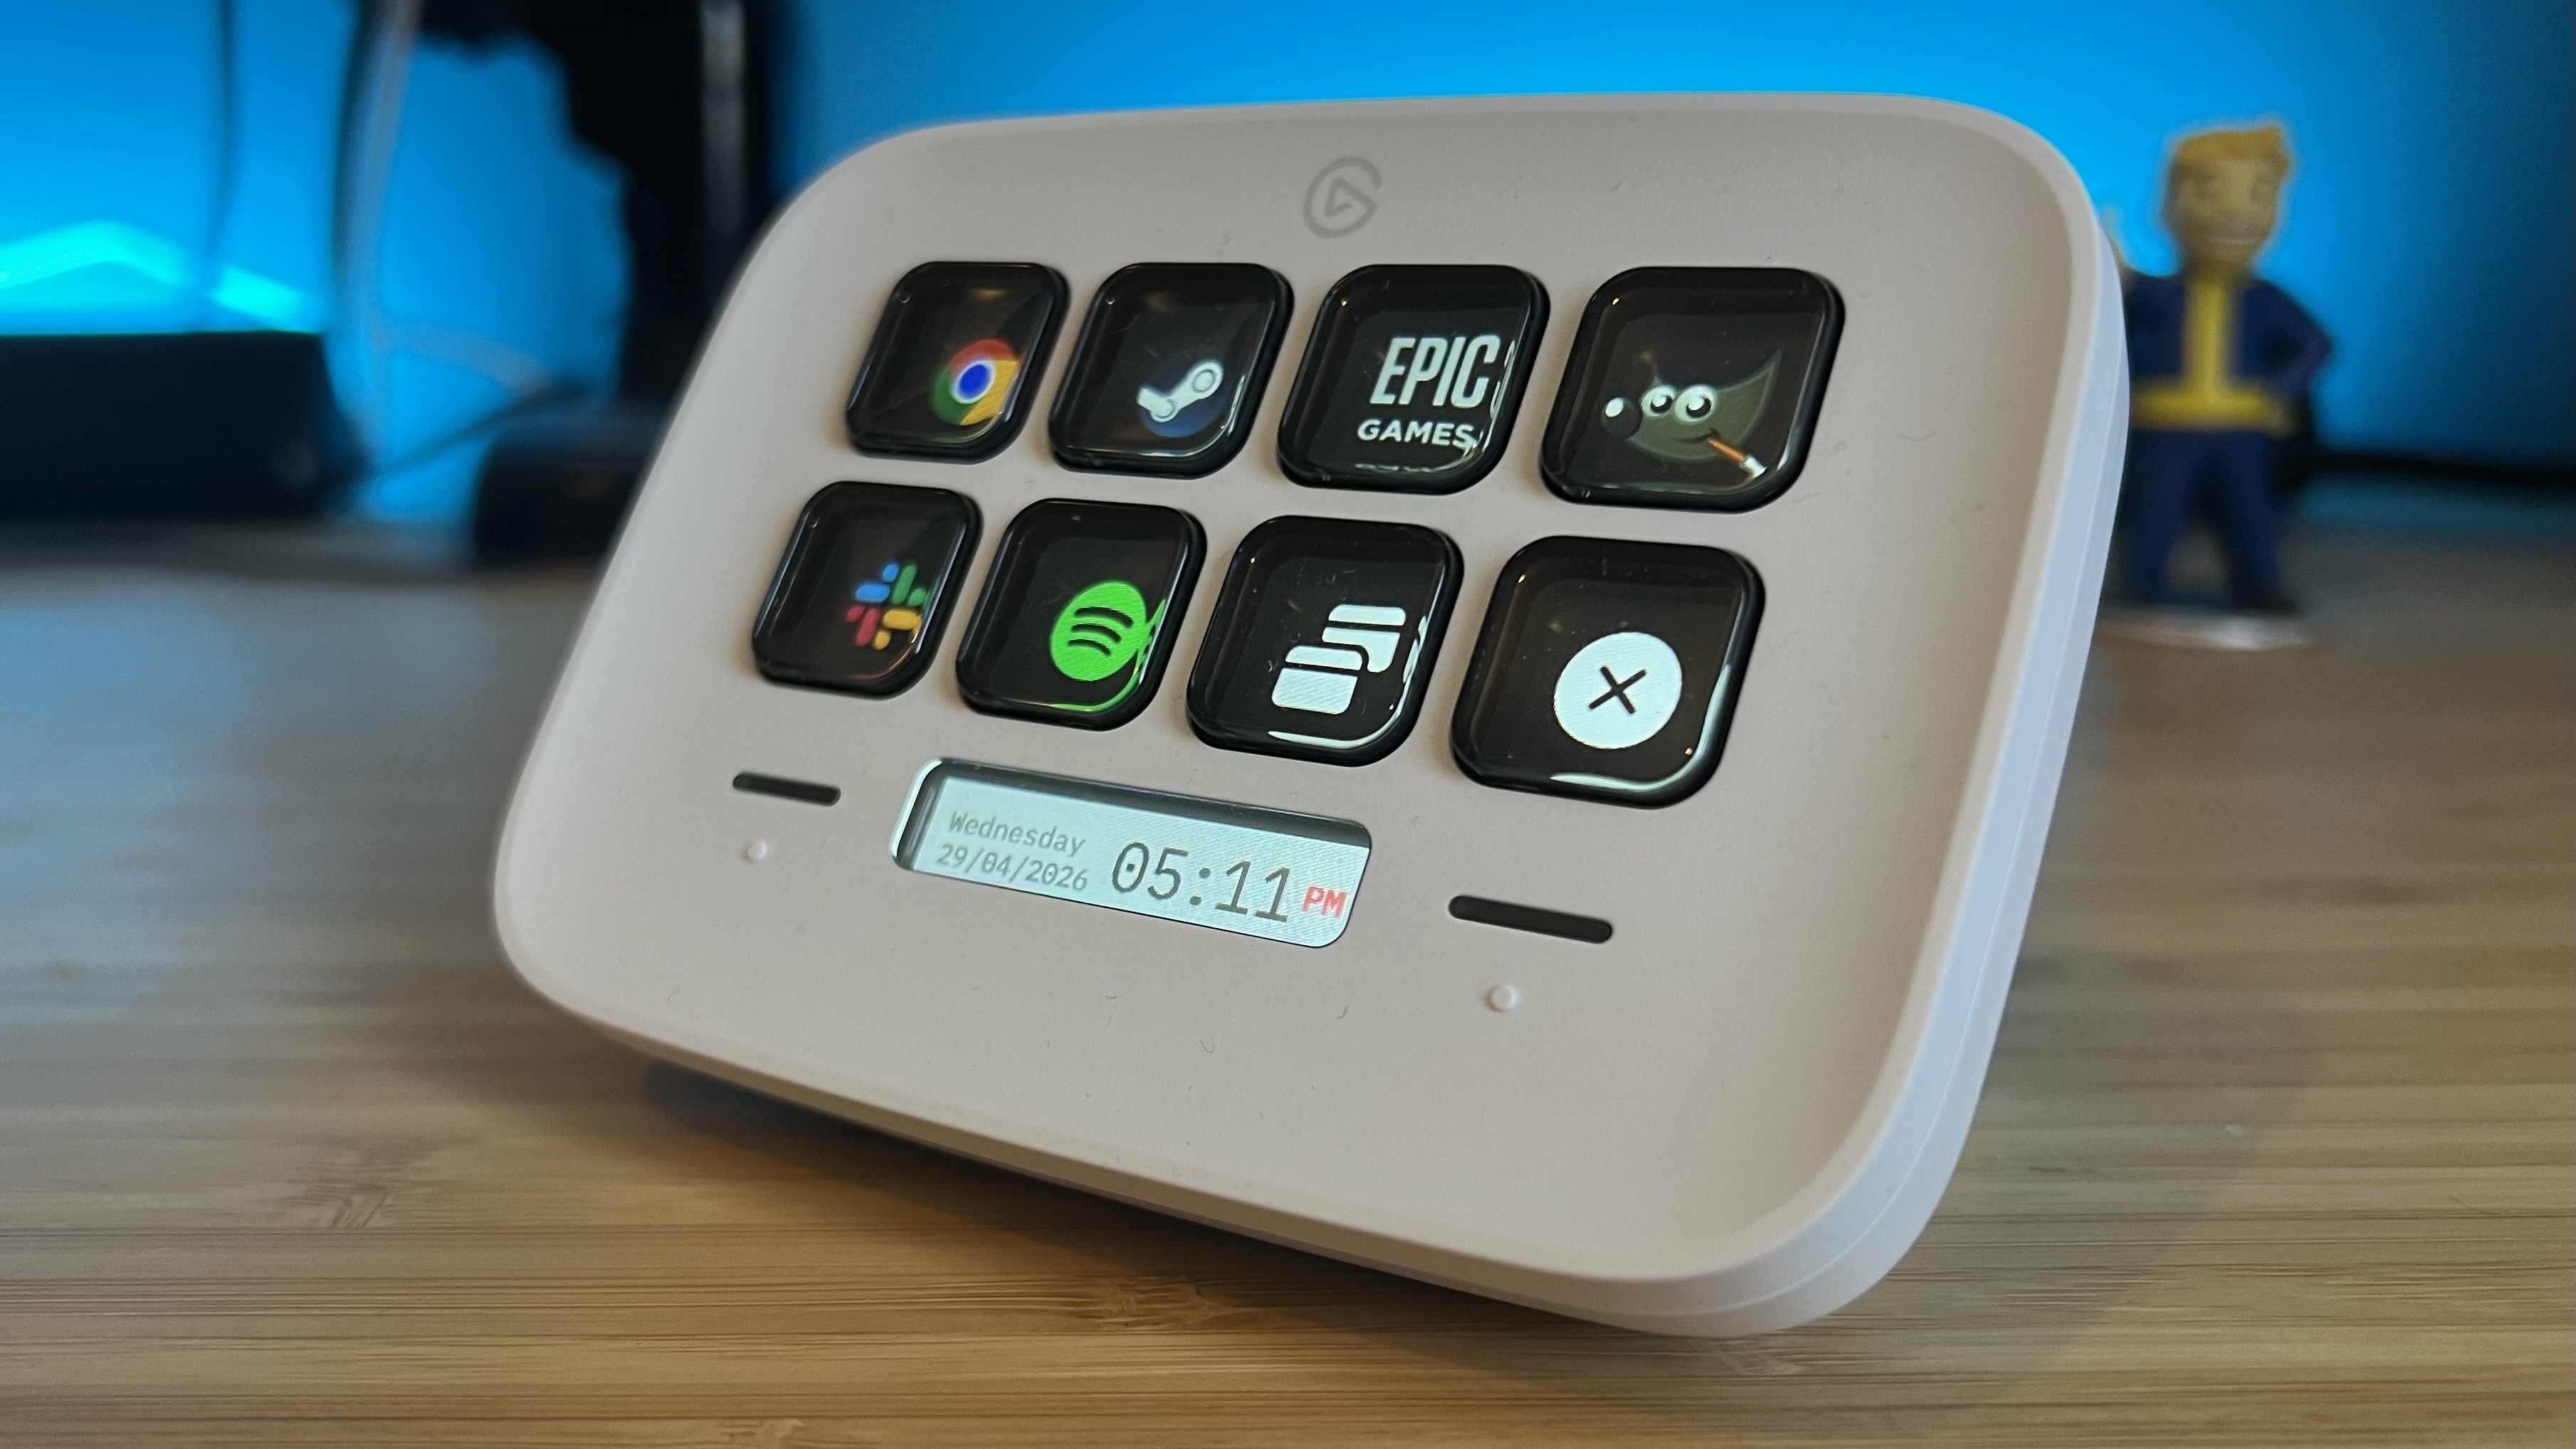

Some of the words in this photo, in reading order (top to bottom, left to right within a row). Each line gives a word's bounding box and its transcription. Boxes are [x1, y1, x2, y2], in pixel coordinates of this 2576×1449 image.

[1370, 334, 1500, 409] EPIC
[1357, 418, 1477, 448] GAMES
[949, 811, 1086, 857] Wednesday
[937, 843, 1089, 890] 29/04/2026
[1112, 843, 1291, 922] 05:11
[1303, 887, 1347, 919] PM
